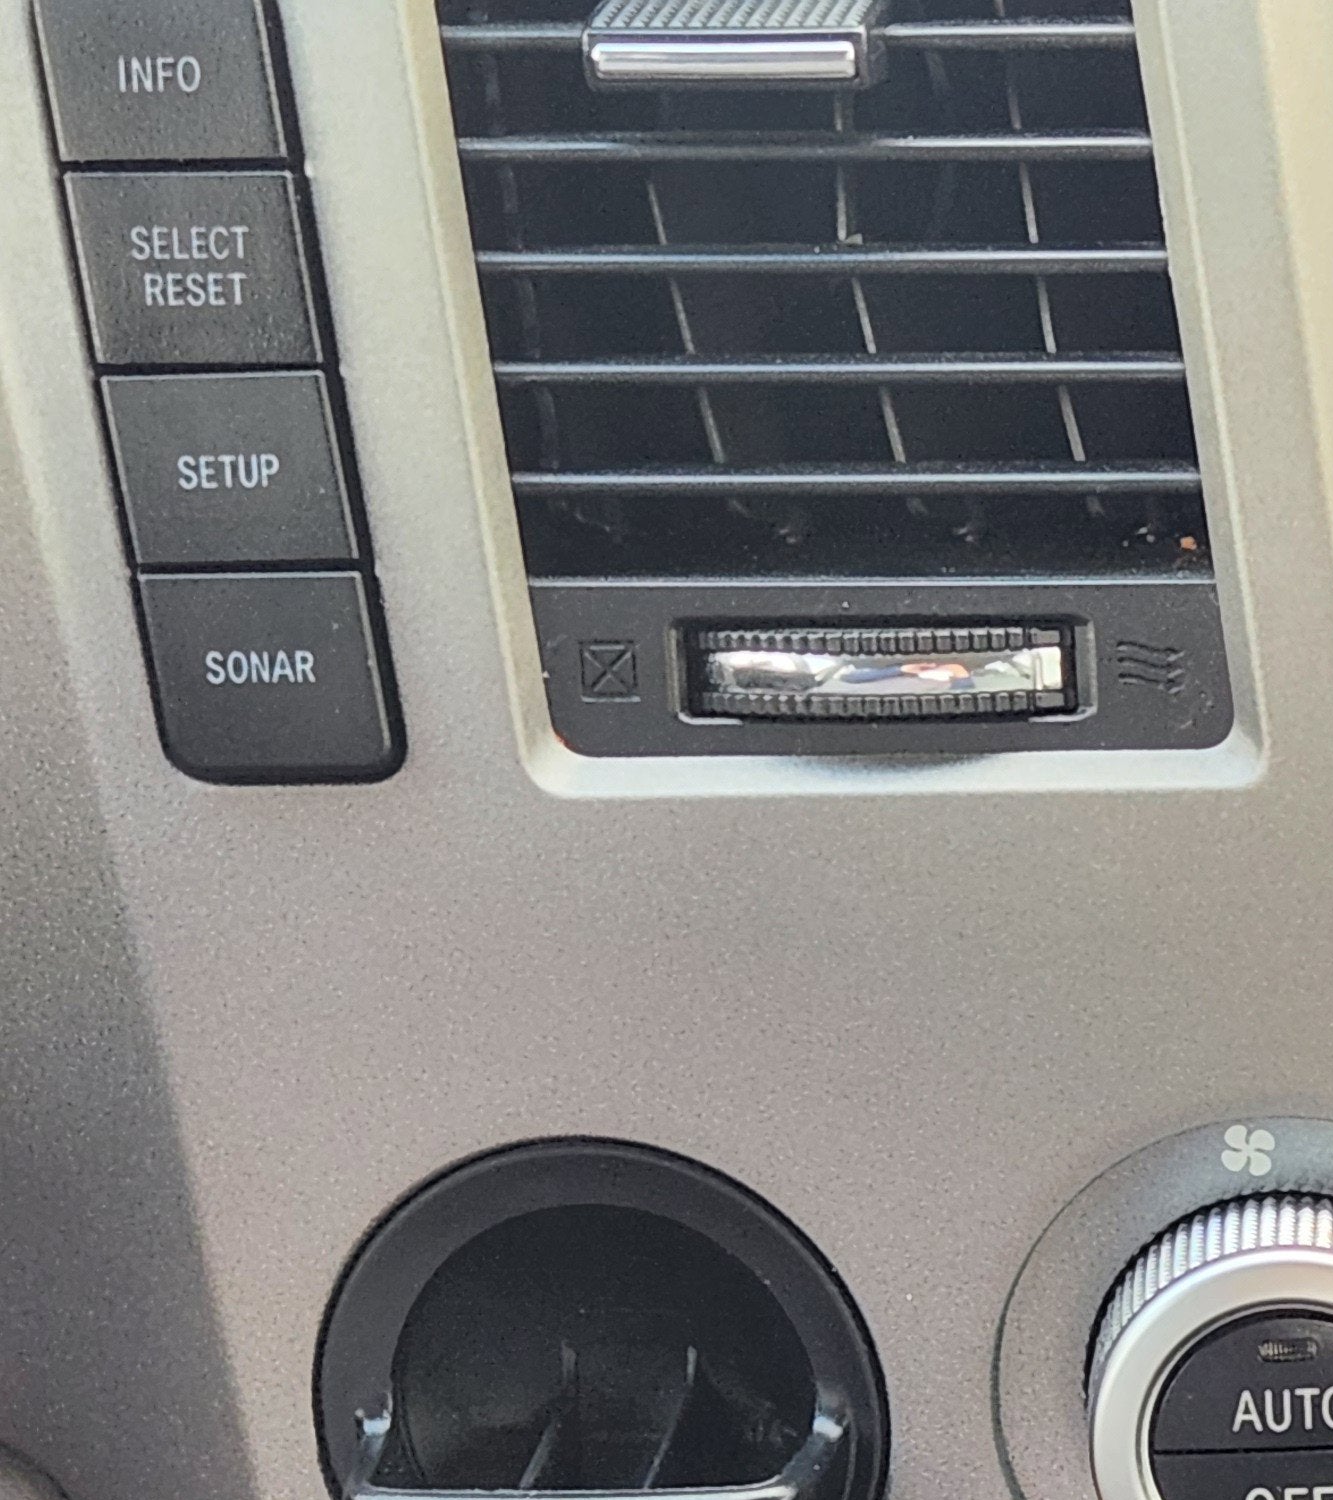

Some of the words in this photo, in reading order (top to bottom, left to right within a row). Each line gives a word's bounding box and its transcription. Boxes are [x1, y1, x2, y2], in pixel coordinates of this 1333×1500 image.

[117, 57, 202, 94] INFO
[130, 225, 250, 261] SELECT
[143, 273, 249, 308] RESET
[176, 453, 281, 490] SETUP
[204, 650, 316, 686] SONAR
